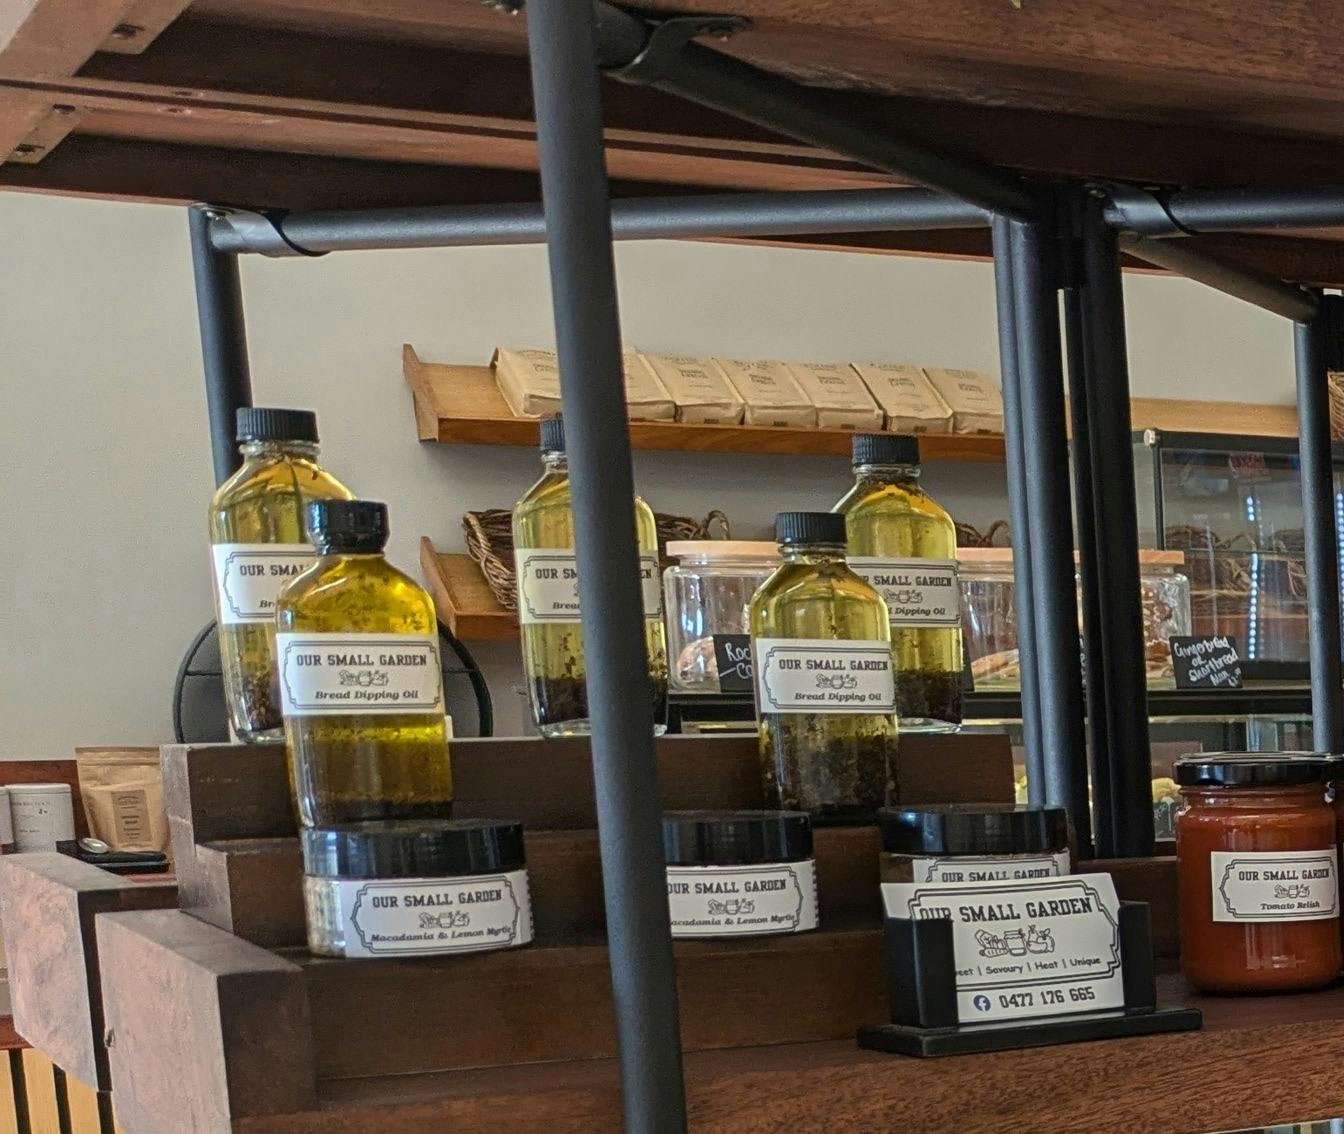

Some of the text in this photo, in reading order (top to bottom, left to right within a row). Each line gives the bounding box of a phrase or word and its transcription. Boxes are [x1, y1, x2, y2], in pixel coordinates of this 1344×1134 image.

[240, 564, 267, 576] OUR
[535, 568, 558, 579] OUR
[874, 576, 952, 586] SMALL GARDEN
[895, 607, 945, 616] Dipping Oil
[296, 654, 427, 665] OUR SMALL GARDEN
[779, 659, 888, 670] OUR SMALL GARDEN
[315, 690, 418, 701] Bread Dipping Oil
[794, 692, 882, 702] Bread Dipping Oil
[942, 868, 1050, 882] OUR SMALL GARDEN
[1238, 868, 1330, 881] OUR SMALL GARDEN
[695, 879, 786, 893] SMALL GARDEN
[372, 889, 502, 908] OUR SMALL GARDEN
[960, 904, 1021, 922] SMALL
[1026, 897, 1093, 917] GARDEN
[1297, 901, 1320, 910] Relish
[670, 917, 721, 925] acadamia
[737, 917, 768, 925] Lemon
[371, 933, 435, 942] Macadamia
[451, 930, 484, 939] Lemon
[985, 957, 1101, 976] Savoury Heat Unique
[999, 986, 1095, 1008] 0477 176 665
